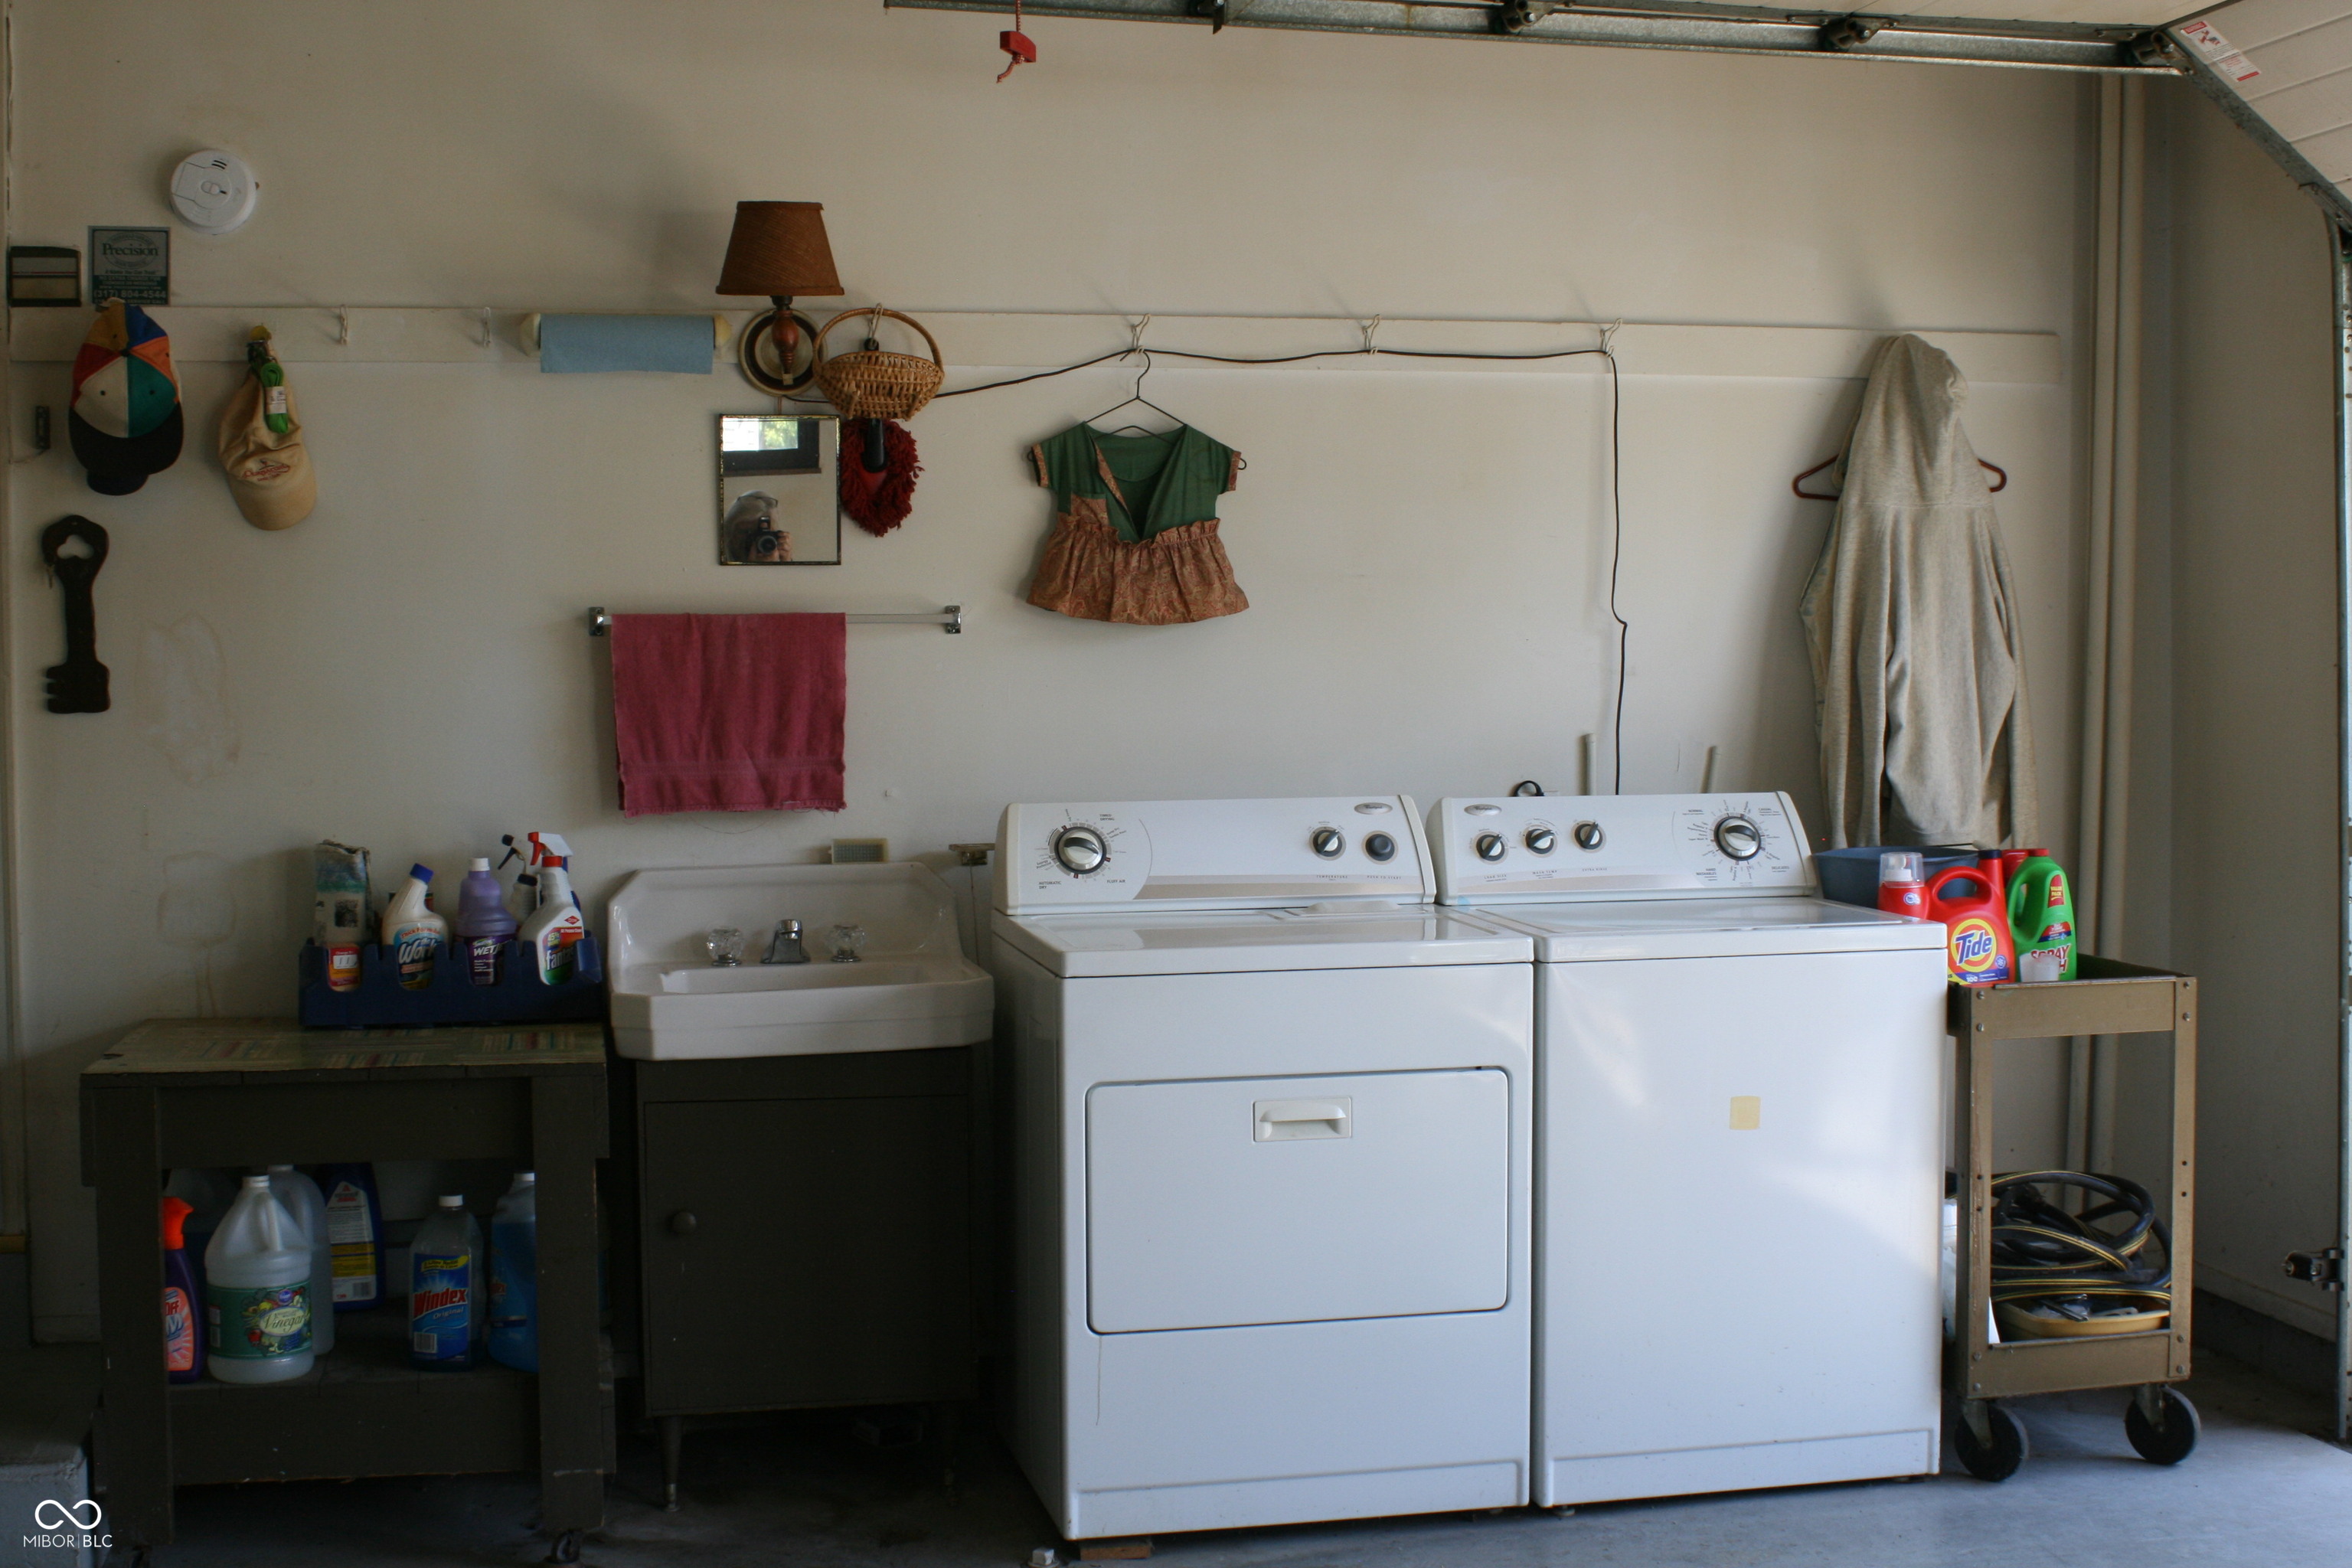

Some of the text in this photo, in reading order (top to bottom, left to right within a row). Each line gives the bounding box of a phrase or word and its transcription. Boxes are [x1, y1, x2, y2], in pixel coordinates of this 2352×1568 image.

[103, 243, 158, 256] Precision
[398, 939, 437, 964] Work
[1954, 930, 1993, 965] Tide
[414, 1287, 468, 1318] Windex
[433, 1306, 464, 1320] Original
[264, 1312, 307, 1333] Vinegar
